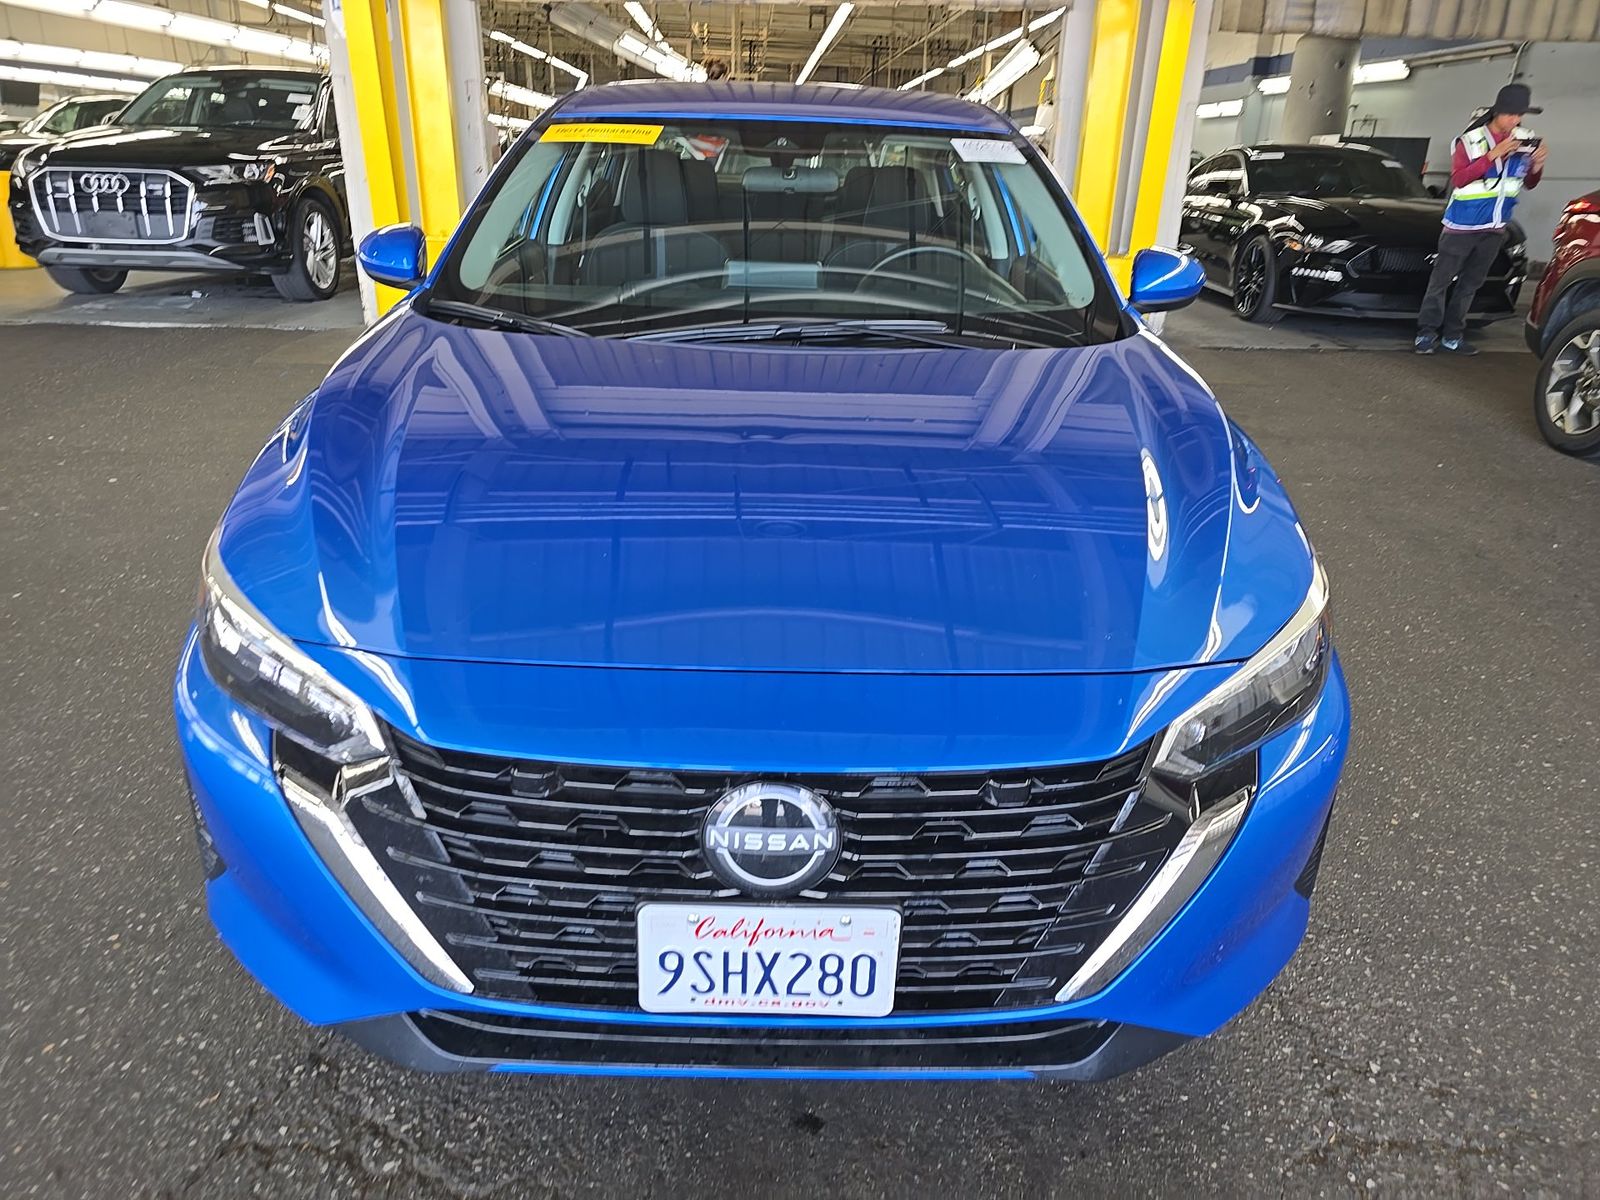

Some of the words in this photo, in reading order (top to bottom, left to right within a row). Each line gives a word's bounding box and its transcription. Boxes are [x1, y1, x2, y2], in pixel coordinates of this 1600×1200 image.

[709, 829, 833, 852] NISSAN
[695, 915, 836, 947] California
[657, 950, 877, 998] 9SHX280
